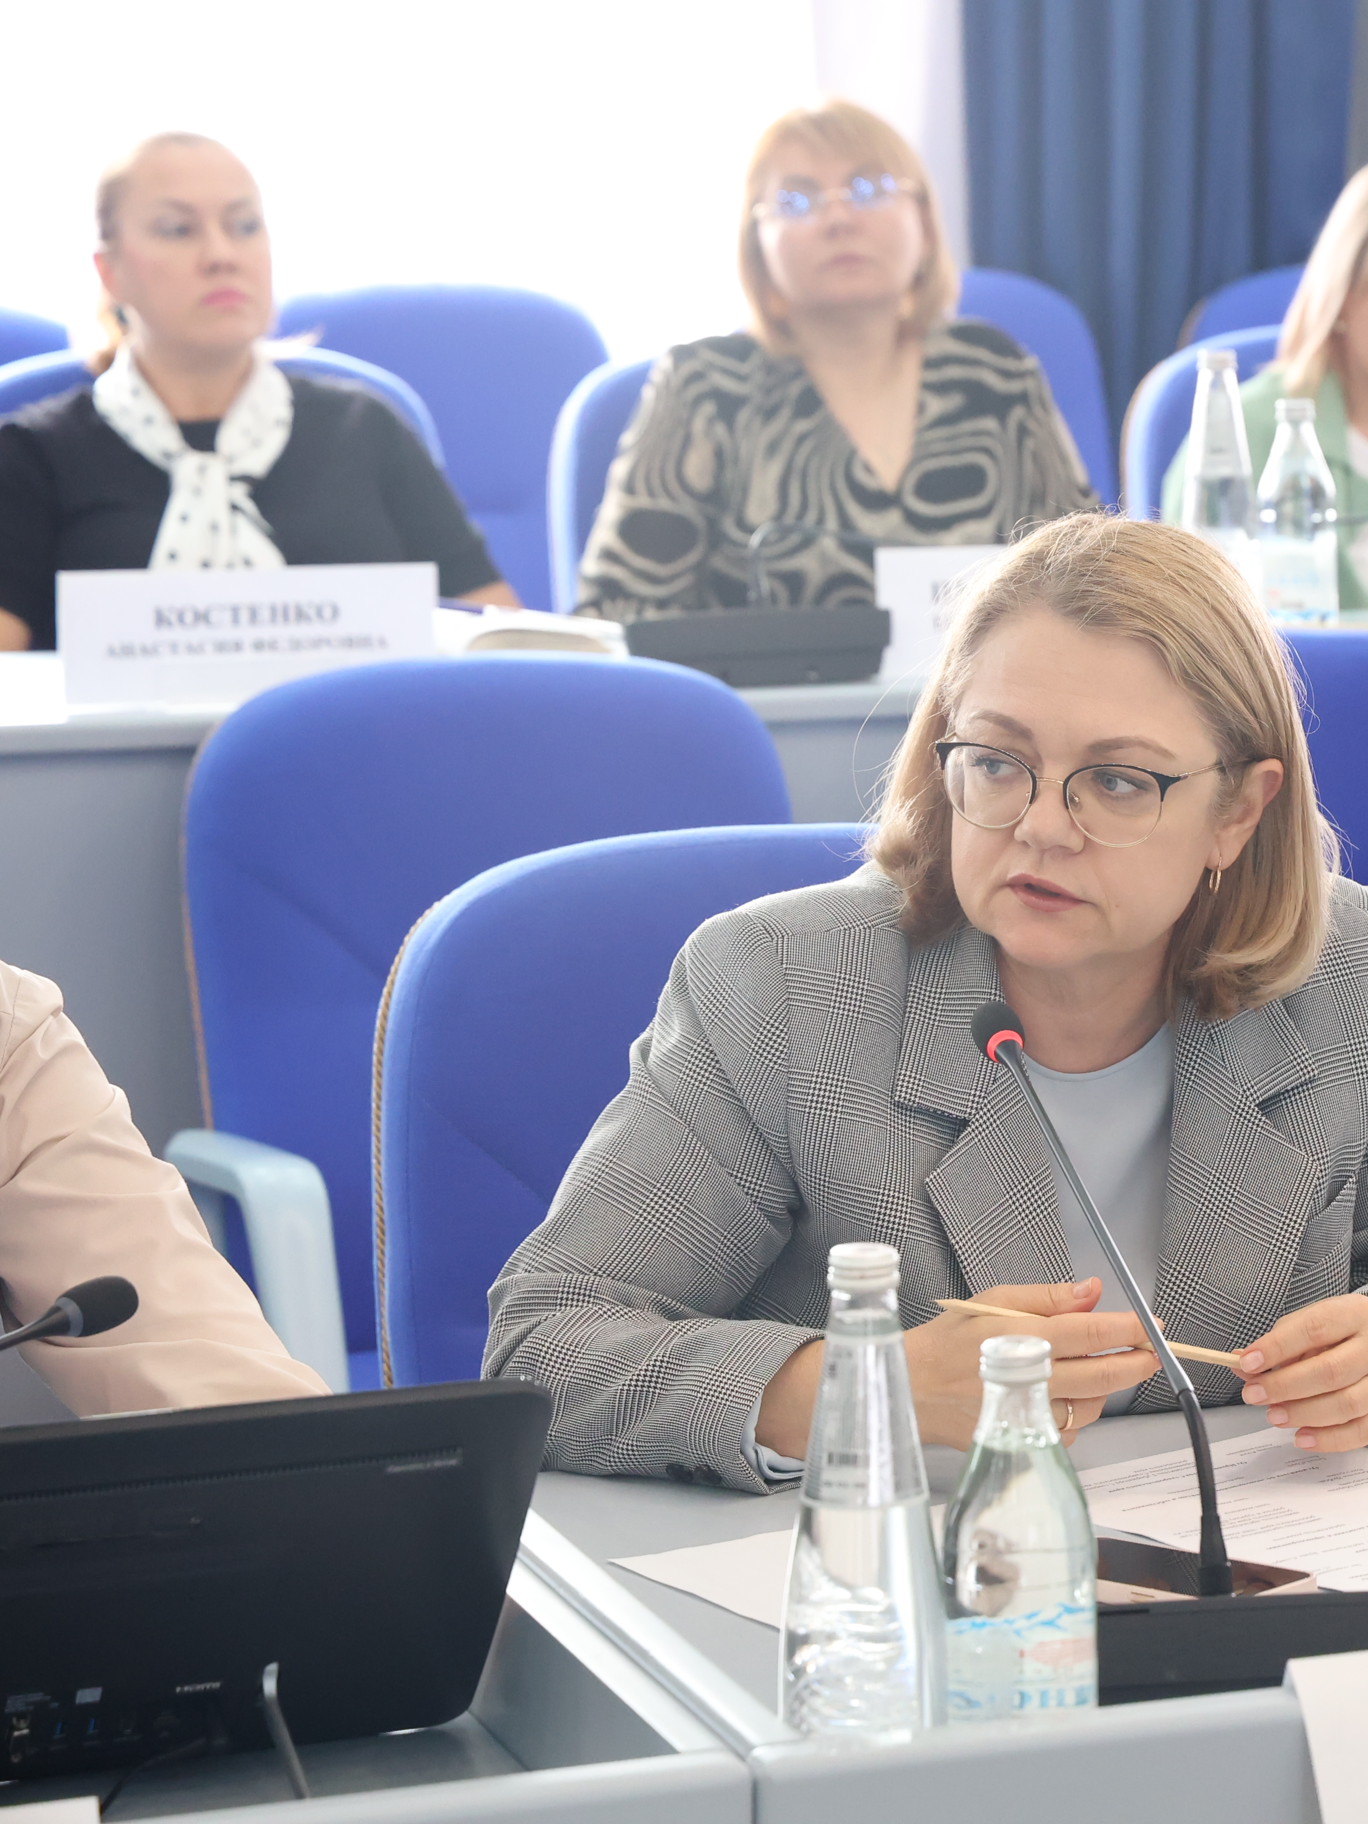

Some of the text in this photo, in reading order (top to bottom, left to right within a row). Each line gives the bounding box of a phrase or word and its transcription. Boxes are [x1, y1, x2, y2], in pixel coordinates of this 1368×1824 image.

[154, 601, 340, 630] КОСТЕНКО
[106, 634, 388, 660] АНАСТАСИЯ ФЕДОРОВНА
